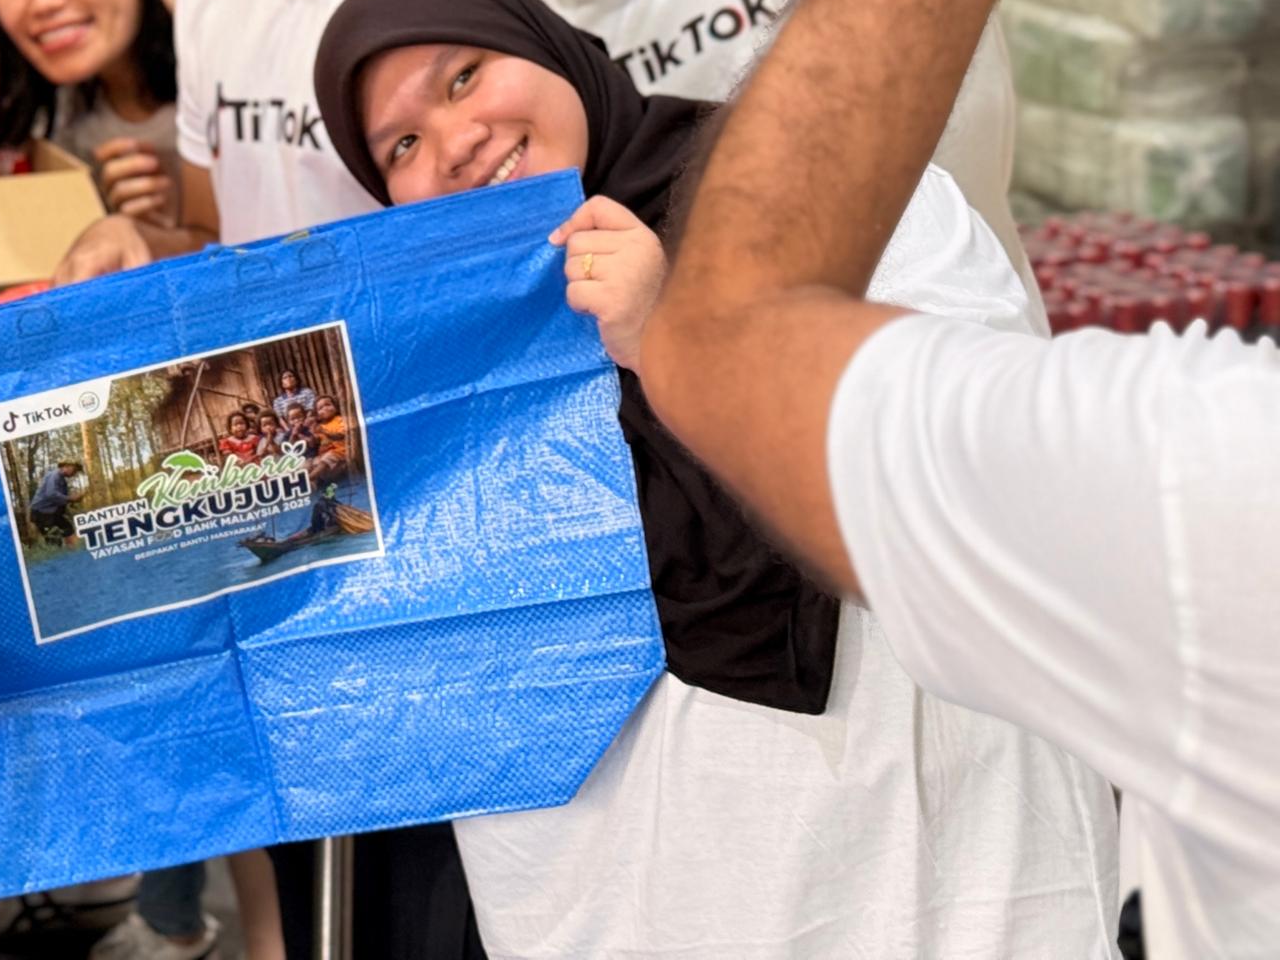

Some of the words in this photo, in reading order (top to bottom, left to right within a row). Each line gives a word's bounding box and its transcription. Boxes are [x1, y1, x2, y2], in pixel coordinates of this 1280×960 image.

[224, 99, 322, 151] TiTok
[23, 404, 72, 425] TikTok
[138, 454, 306, 510] Kembara
[76, 501, 147, 526] BANTUAN
[79, 471, 310, 549] TENGKUJUH
[90, 539, 145, 559] YAYASAN
[185, 521, 218, 535] BANK
[221, 506, 281, 527] MALAYSIA
[282, 497, 311, 513] 2025
[180, 536, 209, 548] BANTU
